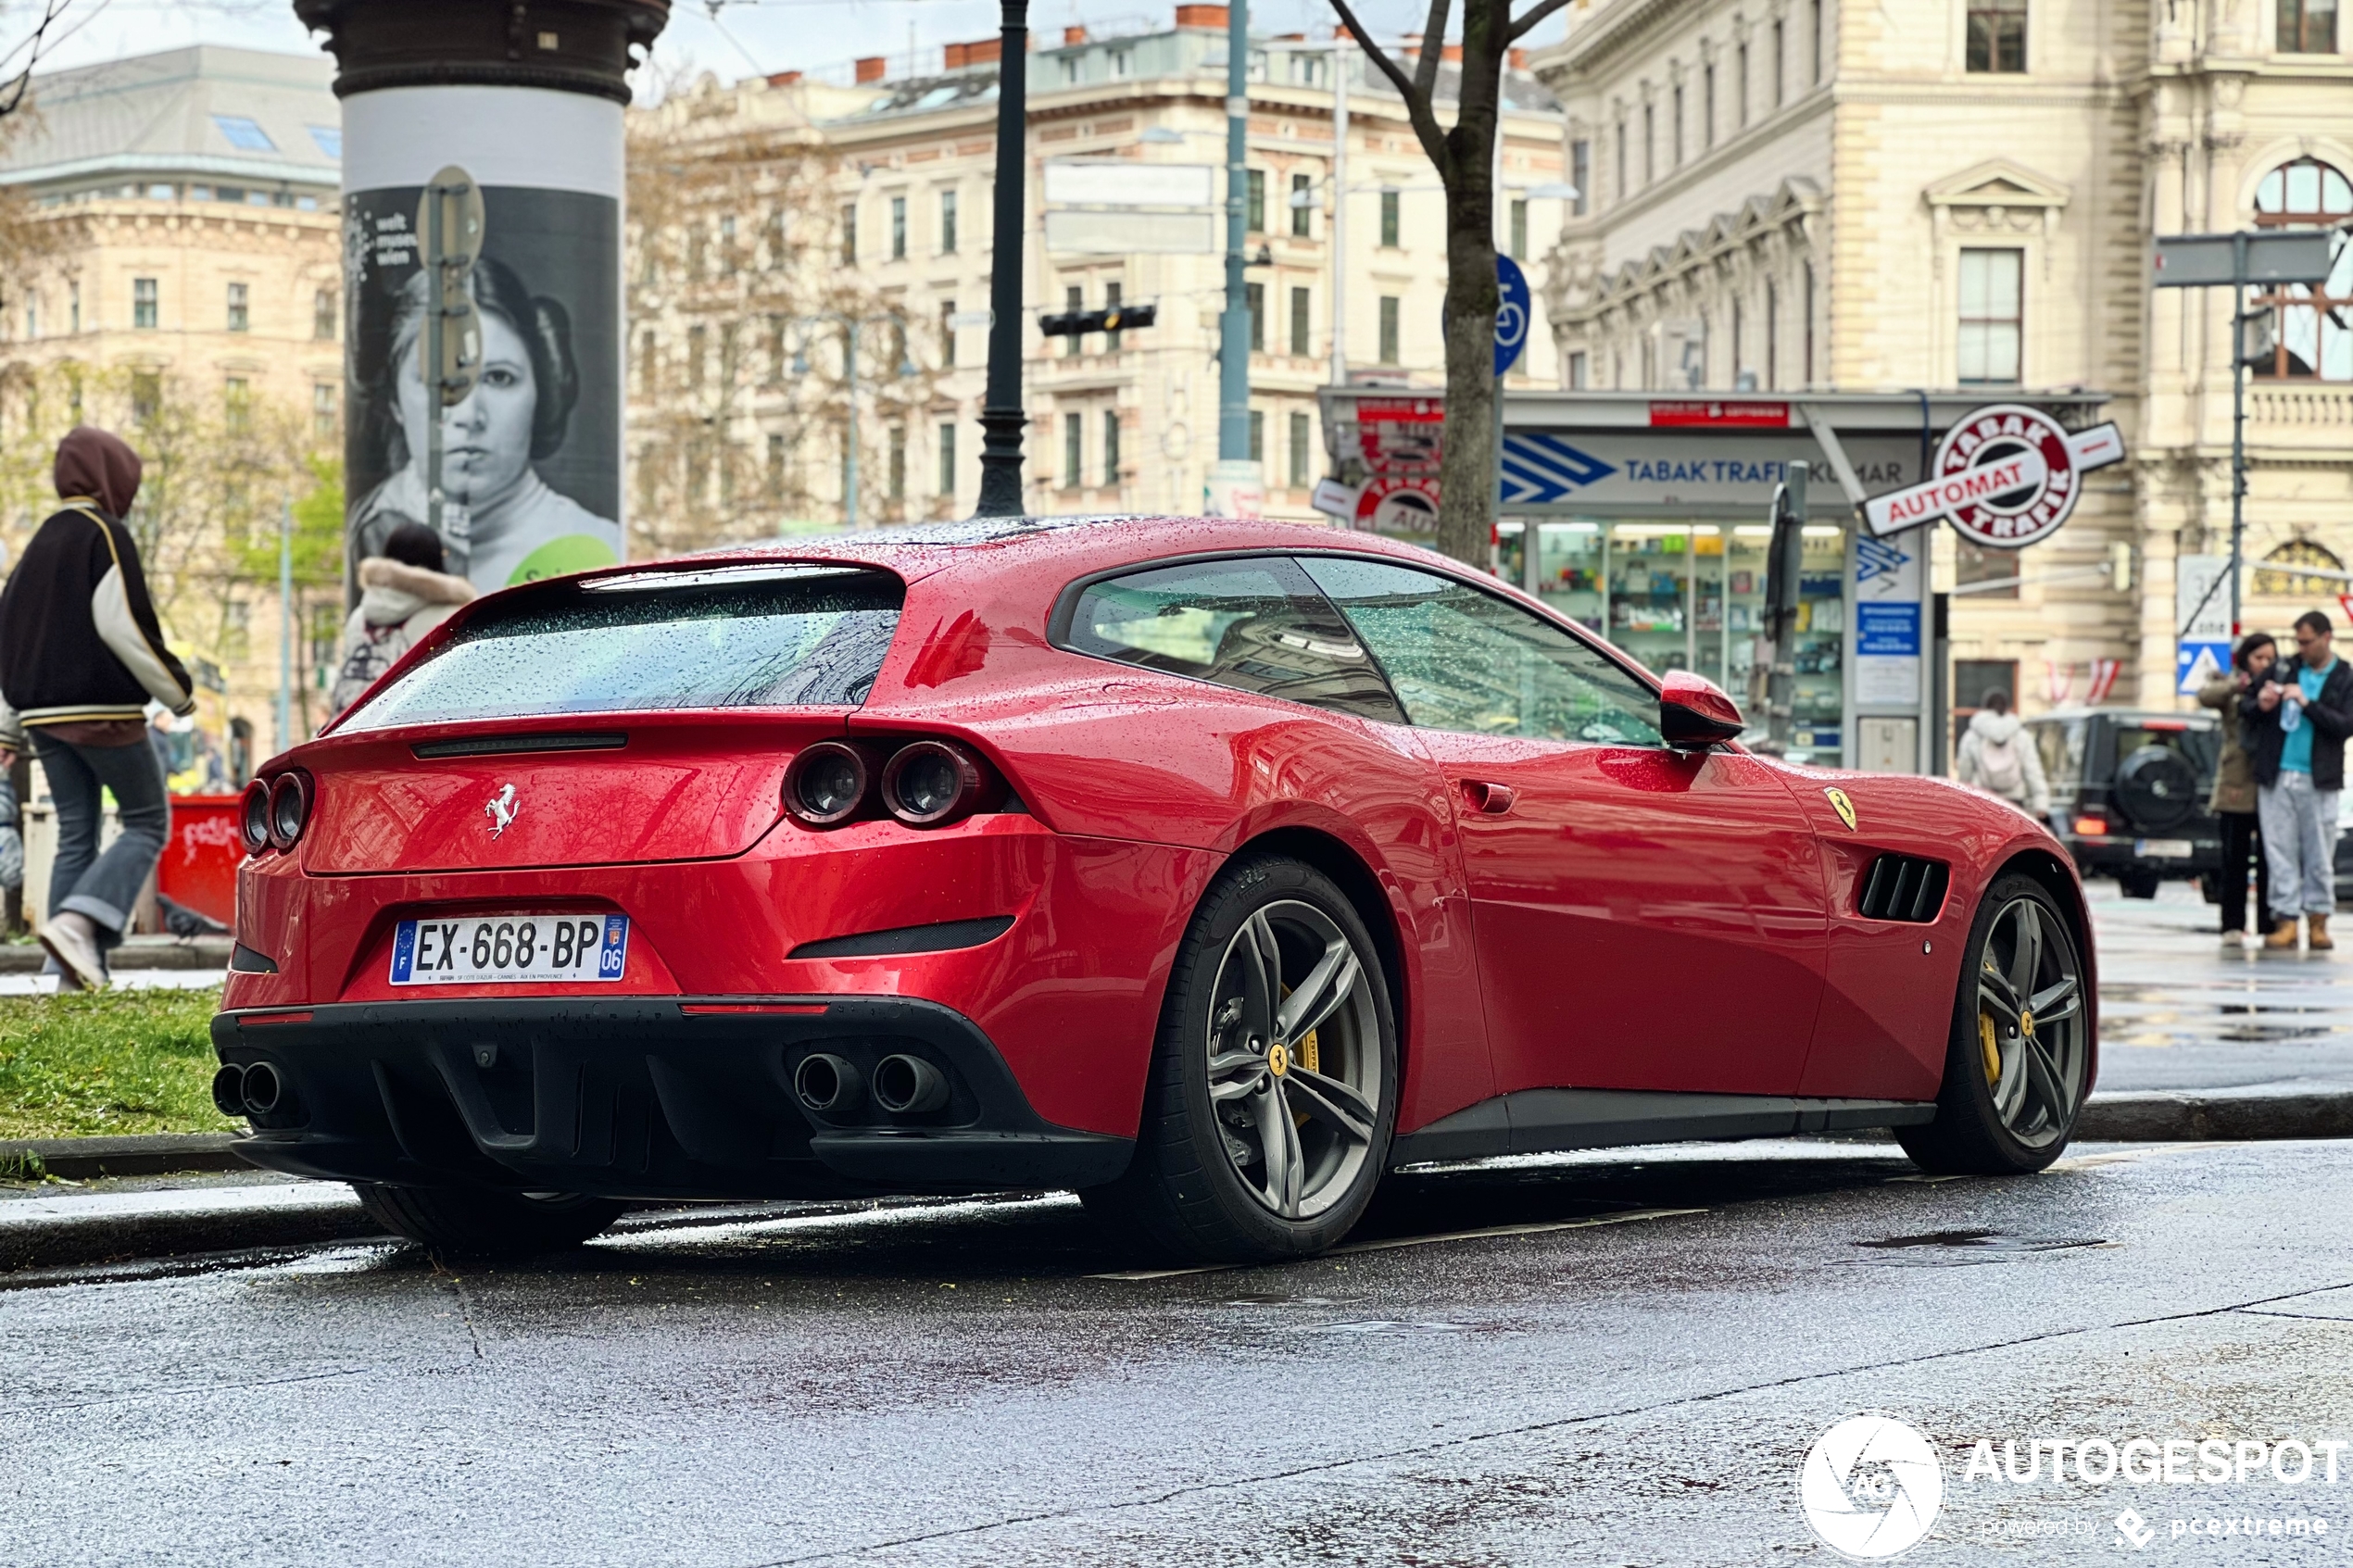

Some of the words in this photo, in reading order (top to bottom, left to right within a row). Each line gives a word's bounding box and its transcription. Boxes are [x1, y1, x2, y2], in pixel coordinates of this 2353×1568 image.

[376, 213, 407, 232] welt
[376, 249, 409, 266] wien
[1946, 415, 2051, 469] TABAK
[1625, 460, 1707, 482] TABAK
[1711, 460, 1785, 483] TRAFI
[1889, 462, 2022, 523] AUTOMAT
[1971, 470, 2070, 536] TRAFIK
[416, 921, 598, 971] EX-668-BP
[398, 957, 407, 970] F
[601, 949, 622, 971] 06
